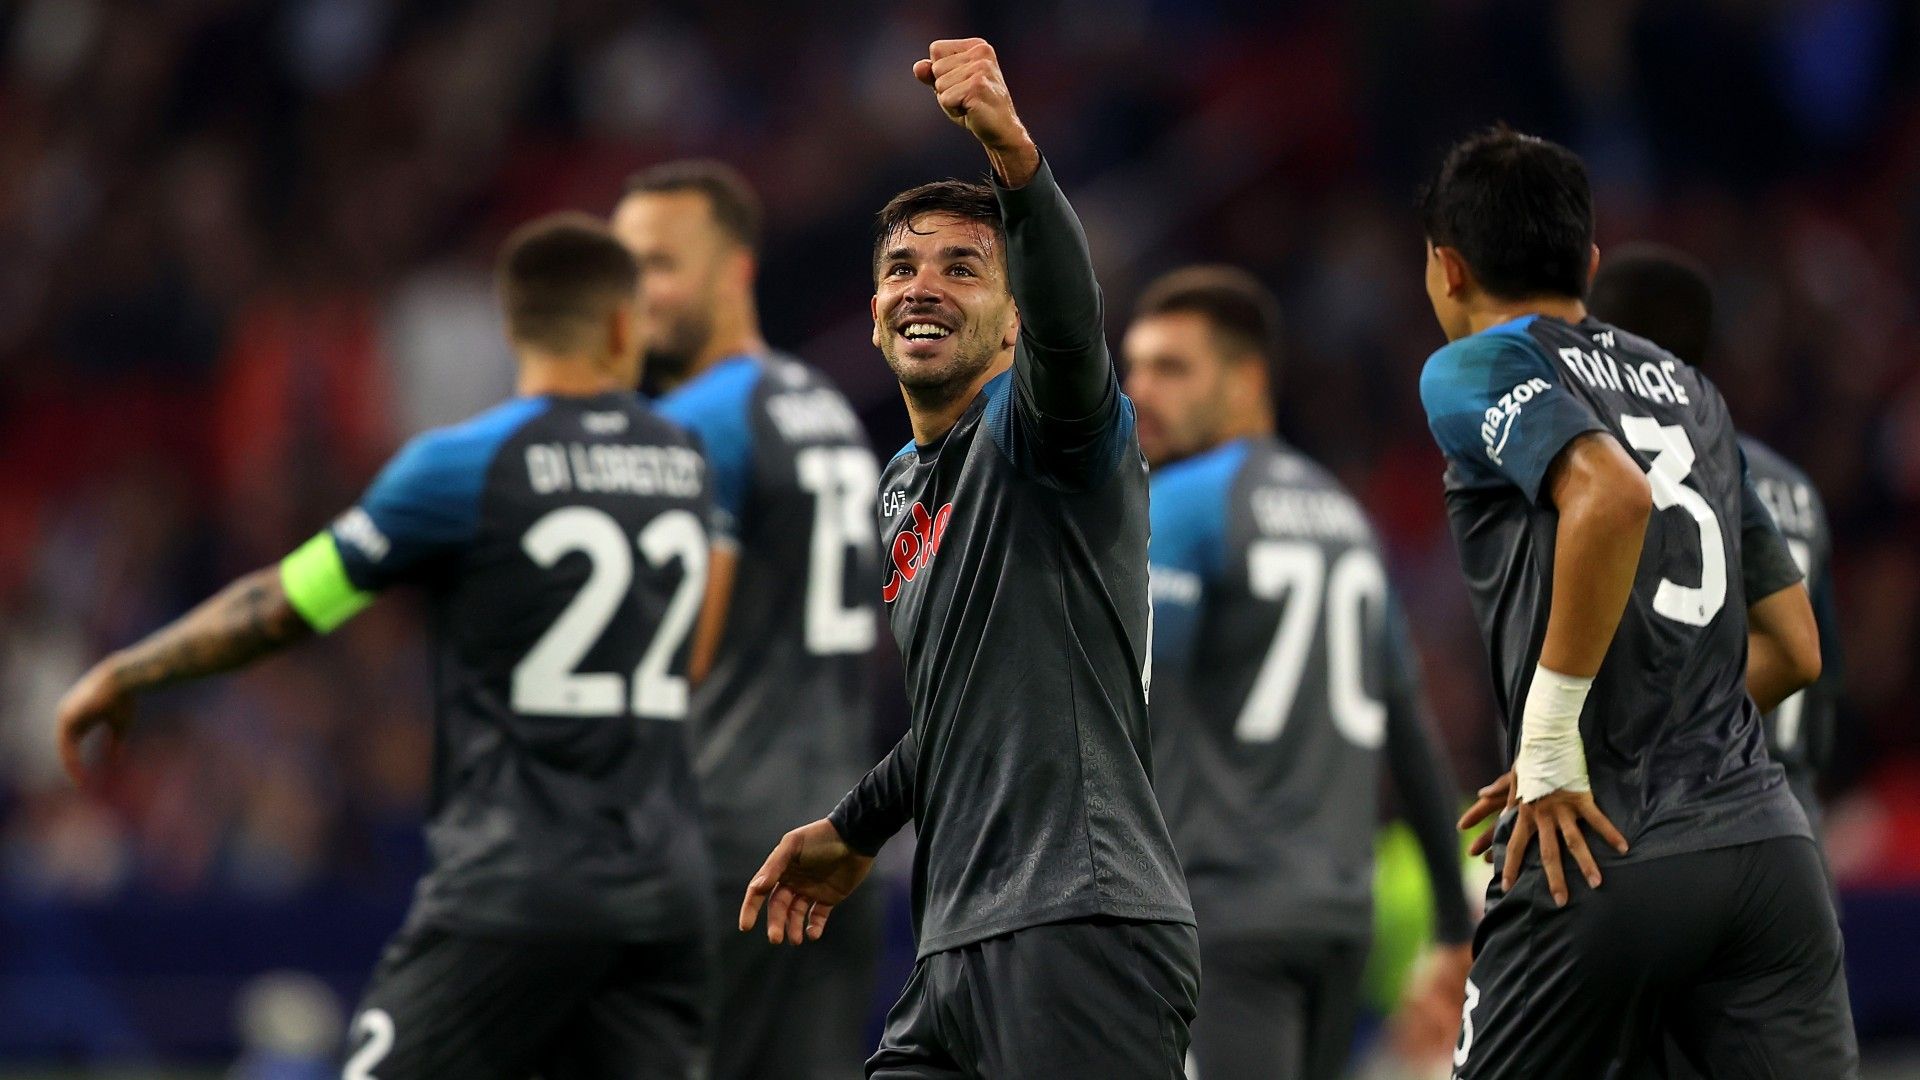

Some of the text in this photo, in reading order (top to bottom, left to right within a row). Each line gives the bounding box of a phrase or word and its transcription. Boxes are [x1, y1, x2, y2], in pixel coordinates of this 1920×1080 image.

[509, 505, 708, 720] 22
[1620, 414, 1727, 627] 3
[1234, 541, 1387, 749] 70
